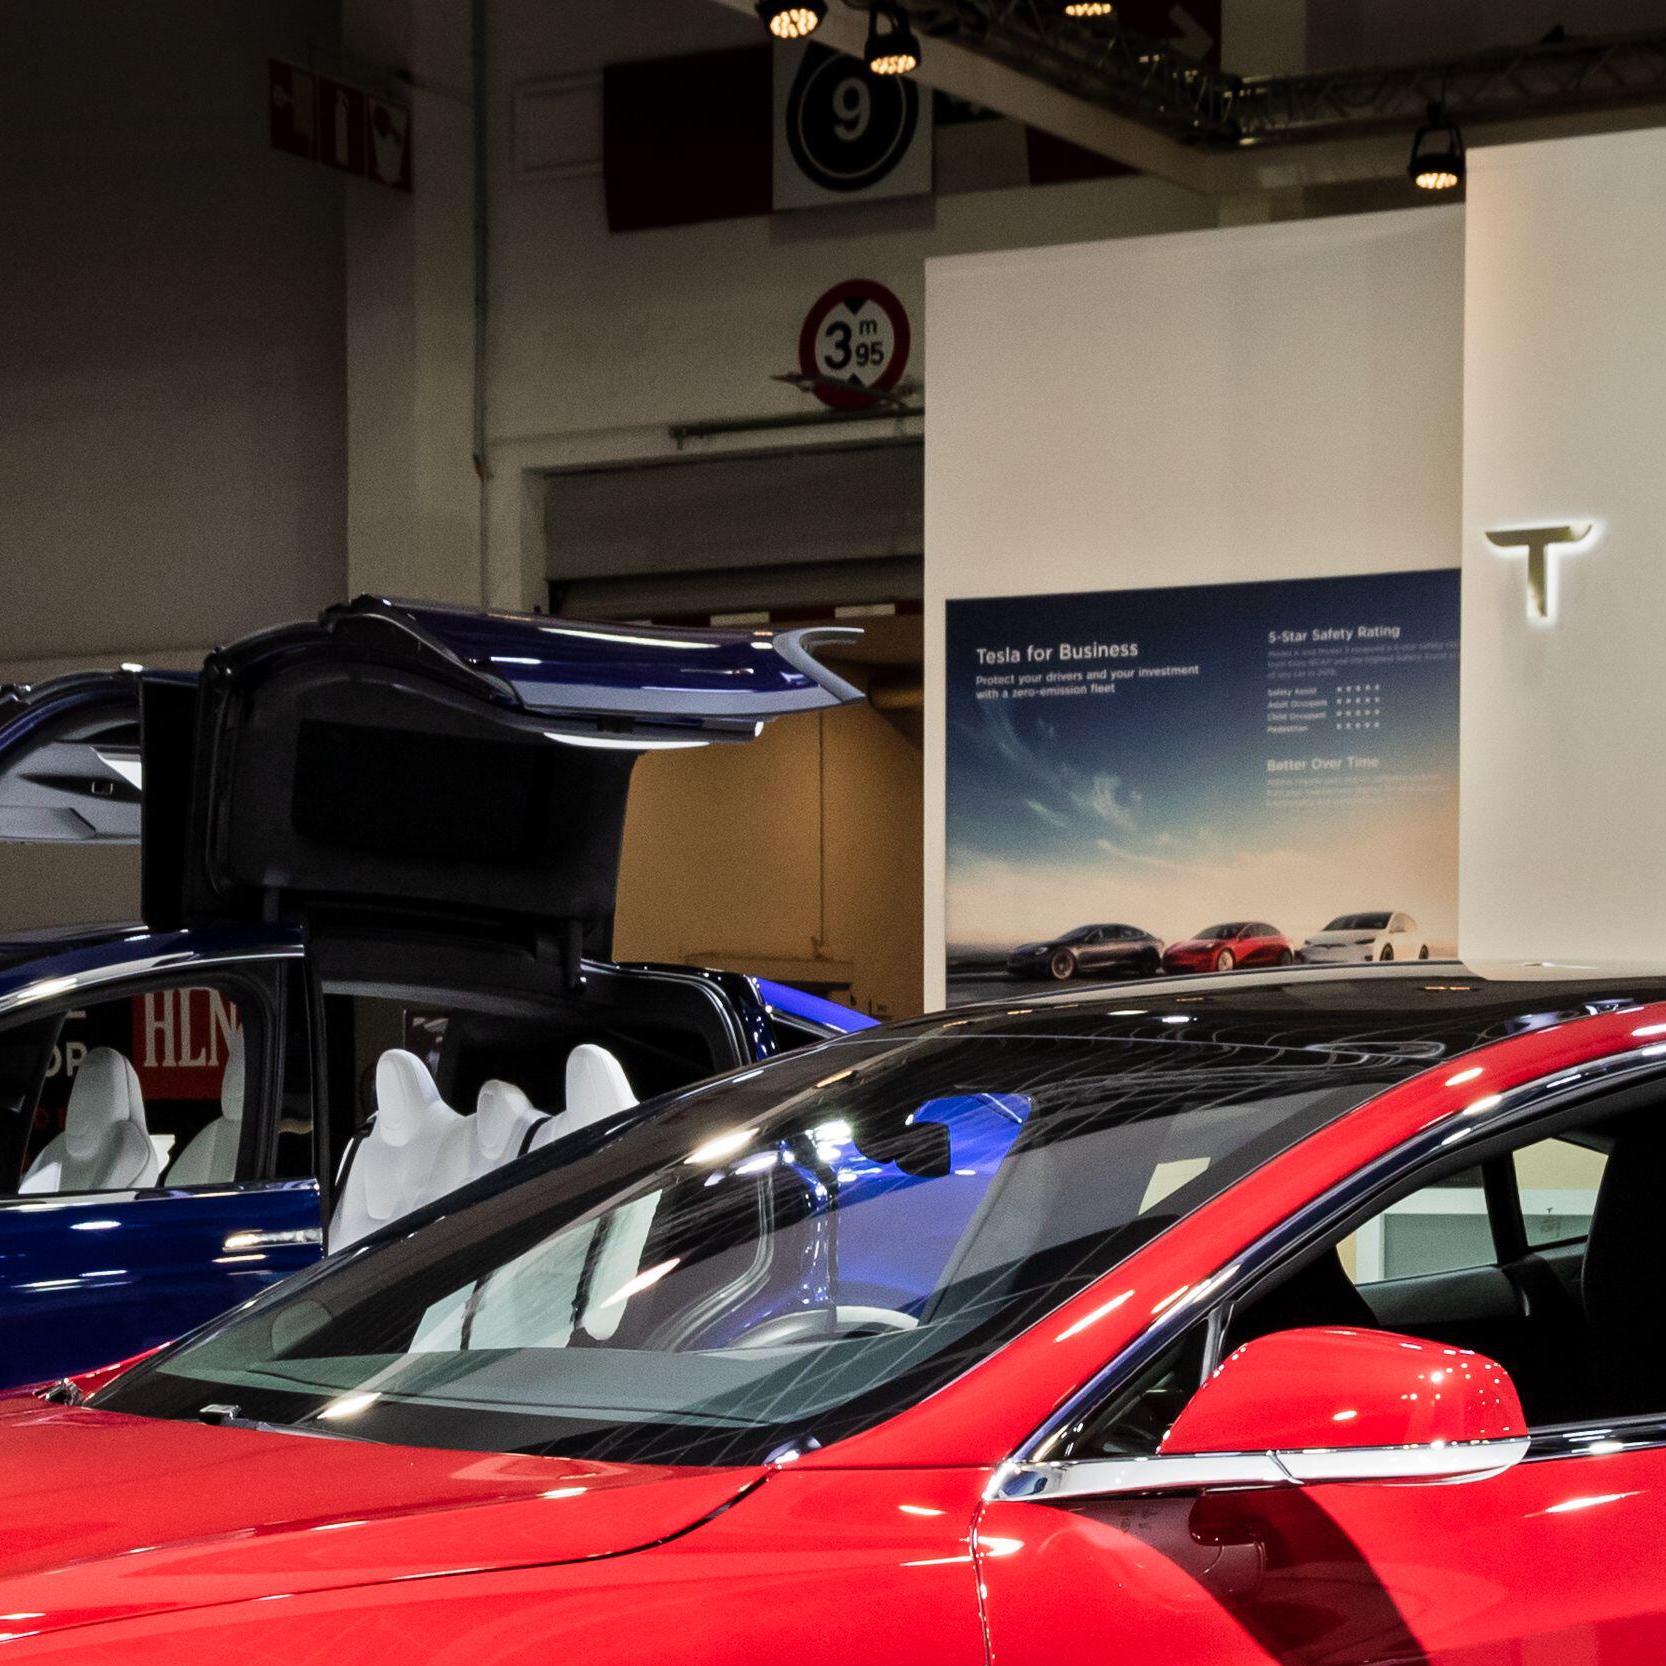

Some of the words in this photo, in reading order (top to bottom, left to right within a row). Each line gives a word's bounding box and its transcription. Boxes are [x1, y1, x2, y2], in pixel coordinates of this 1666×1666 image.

[831, 76, 871, 142] 9
[858, 317, 878, 336] m
[823, 320, 853, 371] 3
[853, 340, 885, 367] 95
[1268, 630, 1308, 644] 5-Star
[1312, 627, 1354, 642] Safety
[1357, 625, 1401, 640] Rating
[976, 646, 1020, 665] Tesla
[1027, 644, 1054, 662] for
[1059, 641, 1139, 661] Business
[975, 675, 1015, 686] Protect
[1018, 673, 1042, 686] your
[1046, 670, 1083, 682] drivers
[1086, 669, 1107, 680] and
[1110, 668, 1136, 681] your
[1138, 665, 1200, 678] investment
[975, 688, 999, 700] with
[1001, 690, 1009, 699] a
[1012, 685, 1087, 699] zero-emission
[1090, 682, 1116, 694] fleet
[1267, 758, 1307, 771] Better
[1311, 757, 1342, 770] Over
[1347, 755, 1380, 769] Time
[143, 987, 239, 1068] HLN
